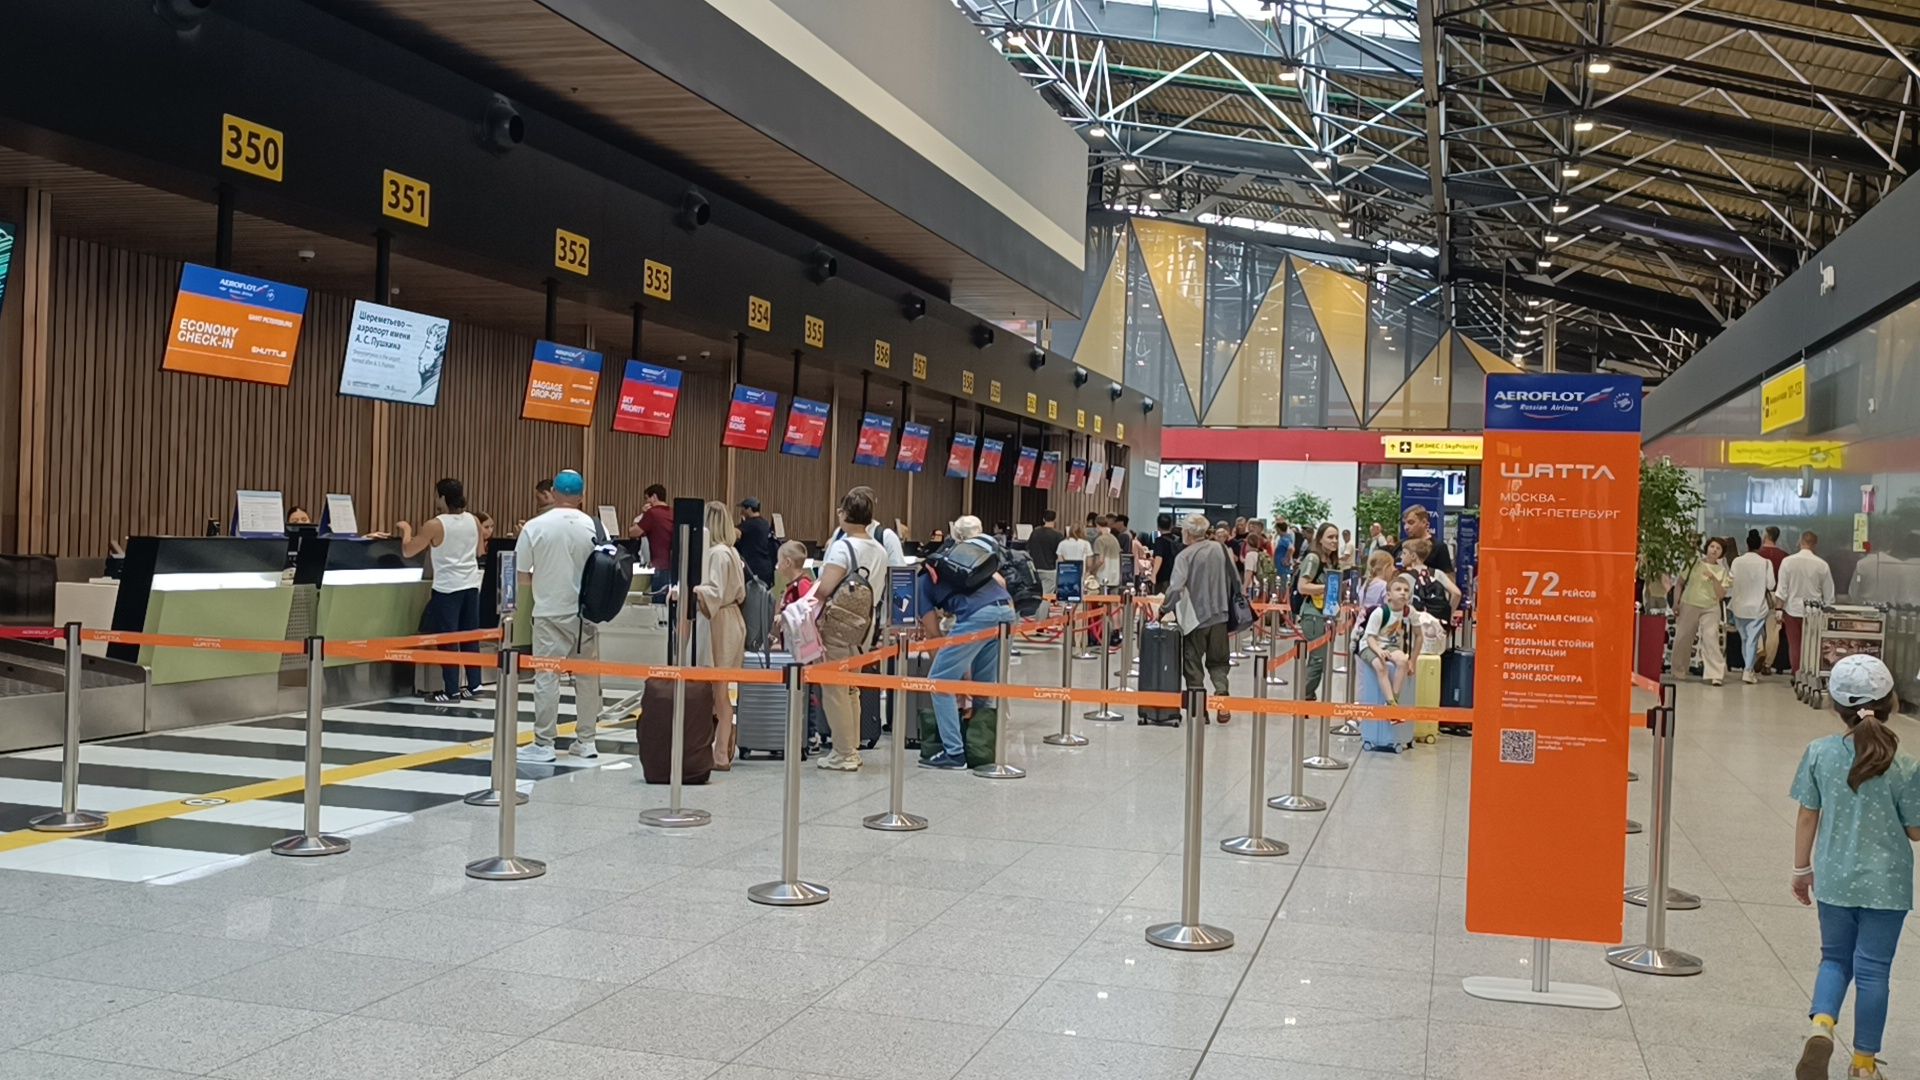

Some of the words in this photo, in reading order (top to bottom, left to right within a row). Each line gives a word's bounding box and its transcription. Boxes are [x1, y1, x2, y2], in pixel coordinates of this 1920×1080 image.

[225, 125, 280, 171] 350
[388, 179, 427, 218] 351
[557, 236, 588, 268] 352
[219, 278, 258, 292] AEROFLOT
[645, 266, 670, 294] 353
[359, 310, 406, 328] Шереметьево
[750, 302, 770, 326] 354
[179, 318, 239, 338] ECONOMY
[356, 323, 389, 337] аэропорт
[389, 330, 411, 340] имени
[806, 320, 823, 342] 355
[177, 330, 234, 349] CHECK-IN
[370, 336, 401, 351] Пушкина
[251, 345, 288, 359] SHUTTLE
[876, 344, 890, 364] 356
[532, 378, 563, 393] BAGGAGE
[530, 388, 564, 401] DROP-OFF
[1494, 390, 1586, 402] AEROFLOT
[1519, 403, 1548, 411] Russian
[1550, 403, 1579, 412] Airlines
[1445, 443, 1479, 451] SkyPriority
[1500, 462, 1616, 480] ШАТТЛ
[1500, 492, 1556, 503] МОСКВА
[1499, 507, 1620, 519] САНКТ-ПЕТЕРБУРГ
[1505, 587, 1518, 596] ДО
[1522, 571, 1560, 597] 72
[1562, 588, 1597, 599] РЕЙСОВ
[1505, 597, 1512, 605] В
[1513, 597, 1542, 606] СУТКИ
[1504, 612, 1562, 622] БЕСПЛАТНАЯ
[1563, 614, 1594, 623] СМЕНА
[1503, 637, 1557, 647] ОТДЕЛЬНЫЕ
[1557, 638, 1595, 648] СТОЙКИ
[1503, 647, 1567, 657] РЕГИСТРАЦИИ
[528, 661, 561, 669] ШАТТЛ
[1503, 662, 1555, 672] ПРИОРИТЕТ
[648, 669, 682, 678] ШАТТЛ
[1502, 672, 1509, 680] В
[1510, 672, 1533, 680] ЗОНЕ
[1534, 673, 1583, 683] ДОСМОТРА
[901, 682, 936, 691] ШАТТЛ
[1033, 691, 1072, 700] ШАТТЛ
[1333, 709, 1375, 717] ШАТТЛ
